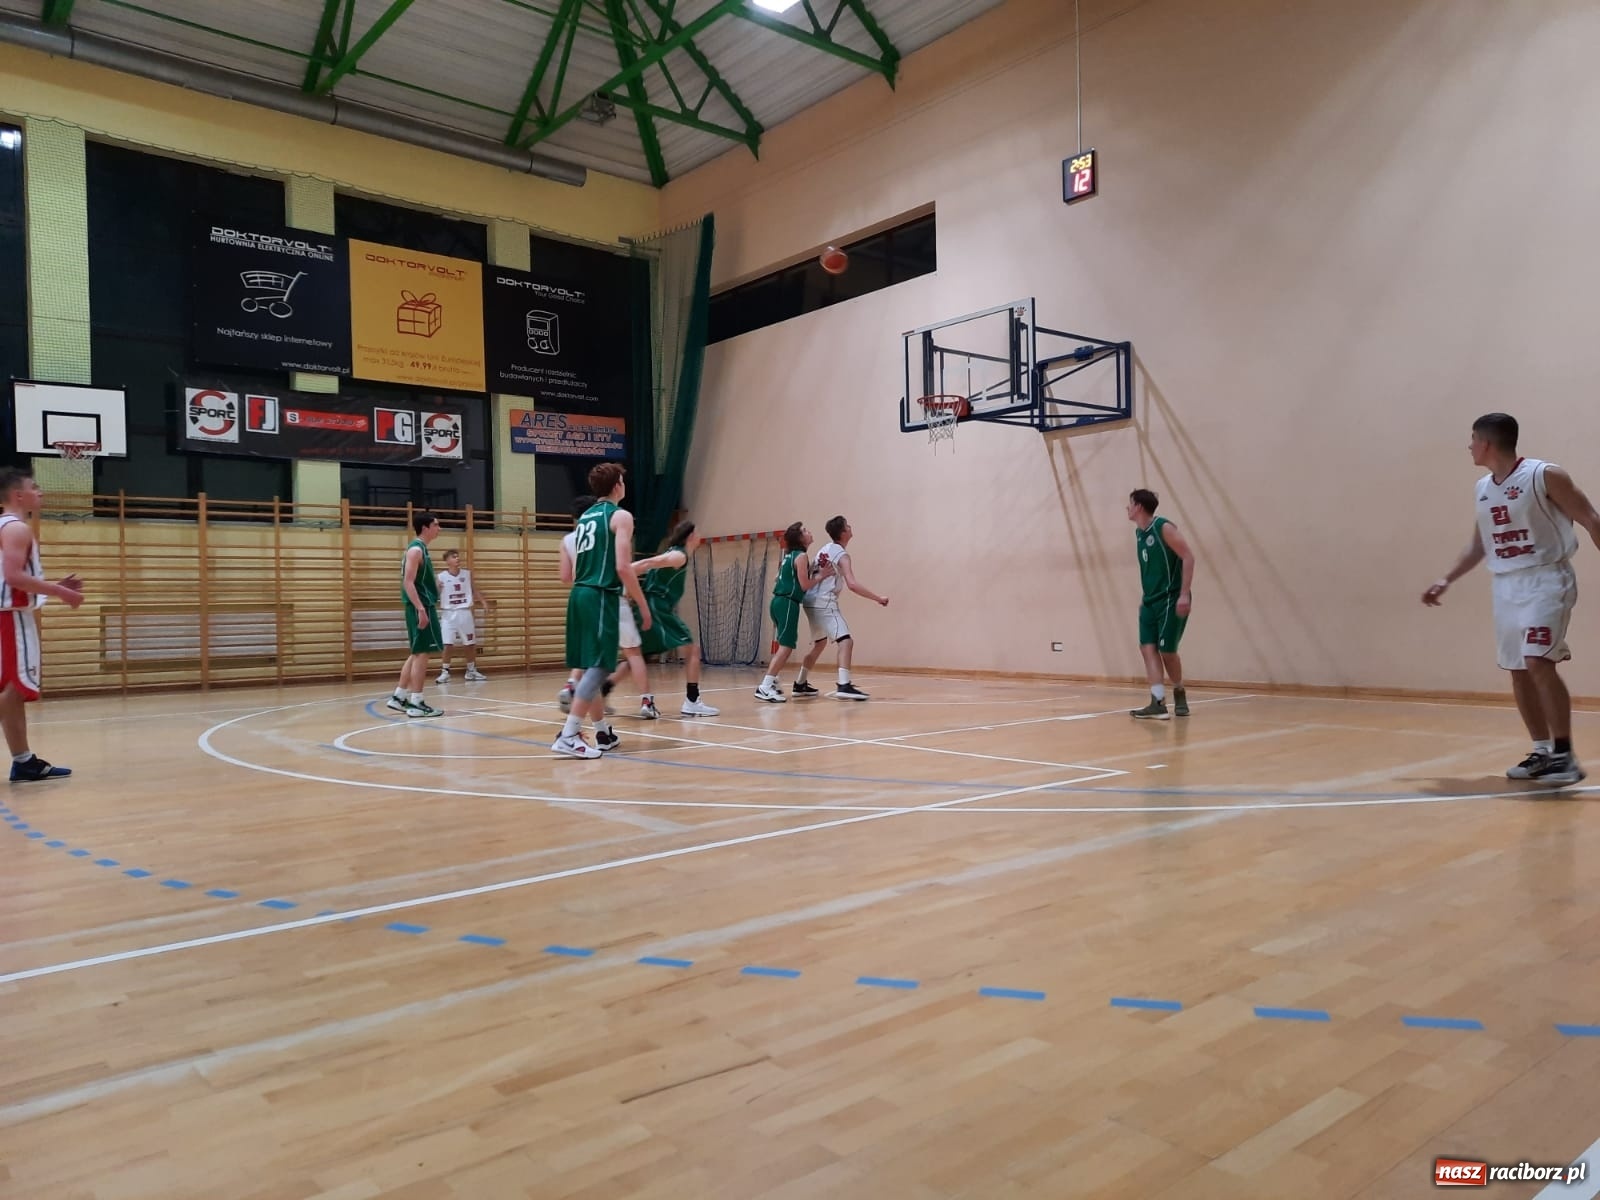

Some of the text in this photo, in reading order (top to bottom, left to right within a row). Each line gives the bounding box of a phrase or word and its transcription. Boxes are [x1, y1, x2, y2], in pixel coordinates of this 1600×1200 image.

[1074, 169, 1091, 192] 12
[210, 235, 256, 249] HURTOWNIA
[307, 251, 334, 262] ONLINE
[211, 226, 332, 253] DOKTORVOLT
[365, 254, 465, 275] DOKTORVOLT
[496, 277, 585, 297] DOKTORVOLT
[260, 333, 283, 343] sklep
[283, 335, 333, 349] internetowy
[520, 412, 568, 429] ARES
[1527, 626, 1552, 646] 23
